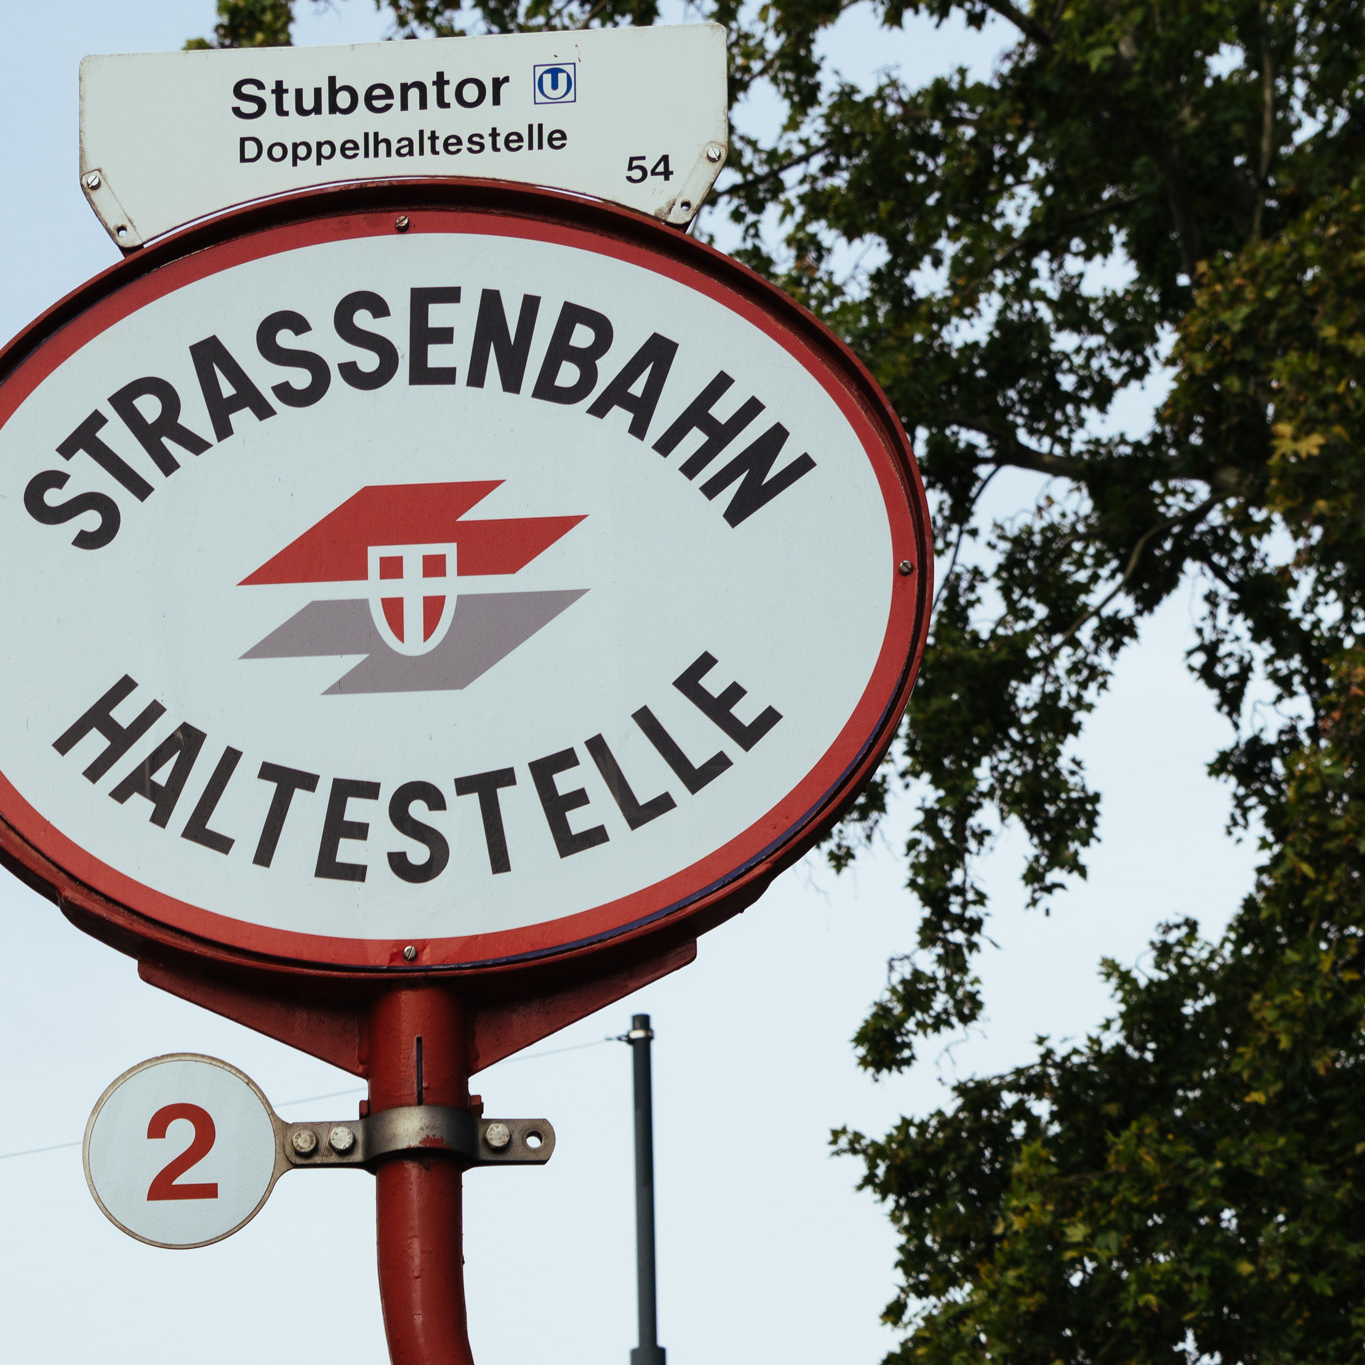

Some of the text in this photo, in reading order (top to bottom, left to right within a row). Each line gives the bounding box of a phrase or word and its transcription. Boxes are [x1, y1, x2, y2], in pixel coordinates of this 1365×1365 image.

[231, 70, 510, 120] Stubentor
[237, 123, 569, 167] Doppelhaltestelle
[625, 154, 675, 186] 54
[23, 286, 816, 550] STRASSENBAHN
[51, 651, 782, 883] HALTESTELLE
[147, 1103, 219, 1201] 2
